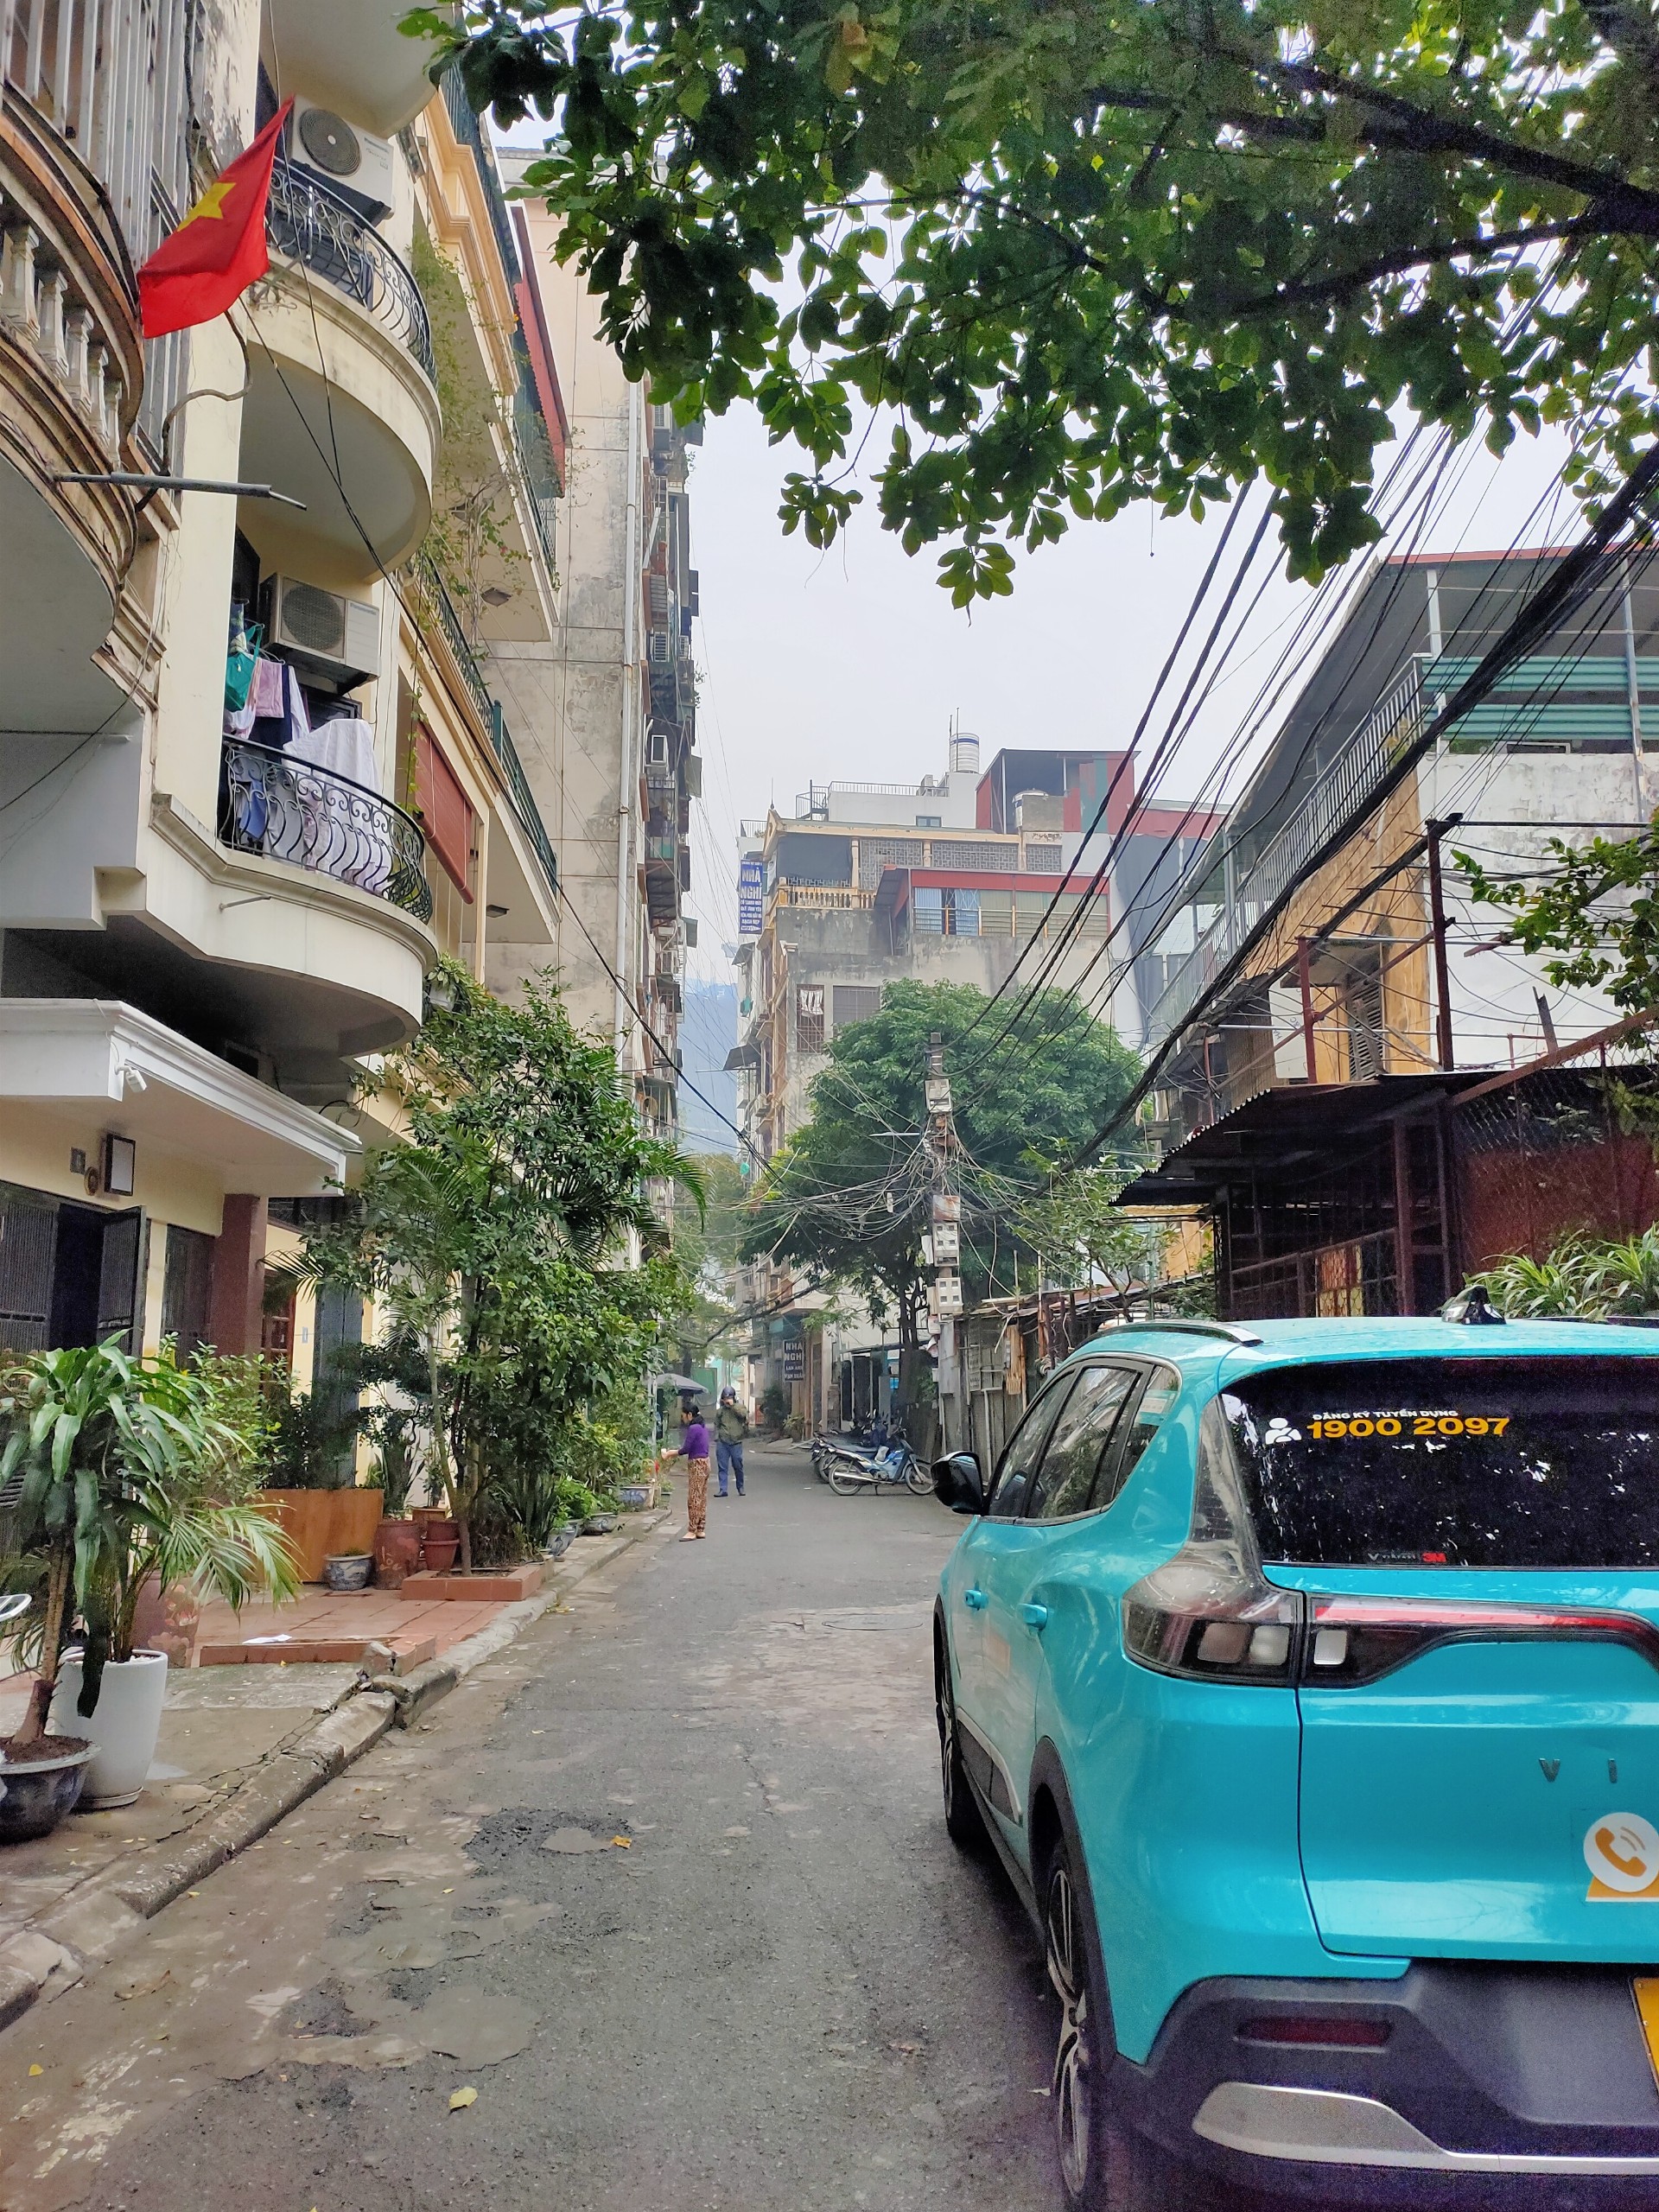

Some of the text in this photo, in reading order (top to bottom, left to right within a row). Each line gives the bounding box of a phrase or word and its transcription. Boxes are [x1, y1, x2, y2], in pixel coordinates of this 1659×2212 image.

[742, 868, 761, 883] NHÀ
[1312, 1411, 1351, 1421] ĐĂNG
[1306, 1417, 1510, 1440] 1900 2097
